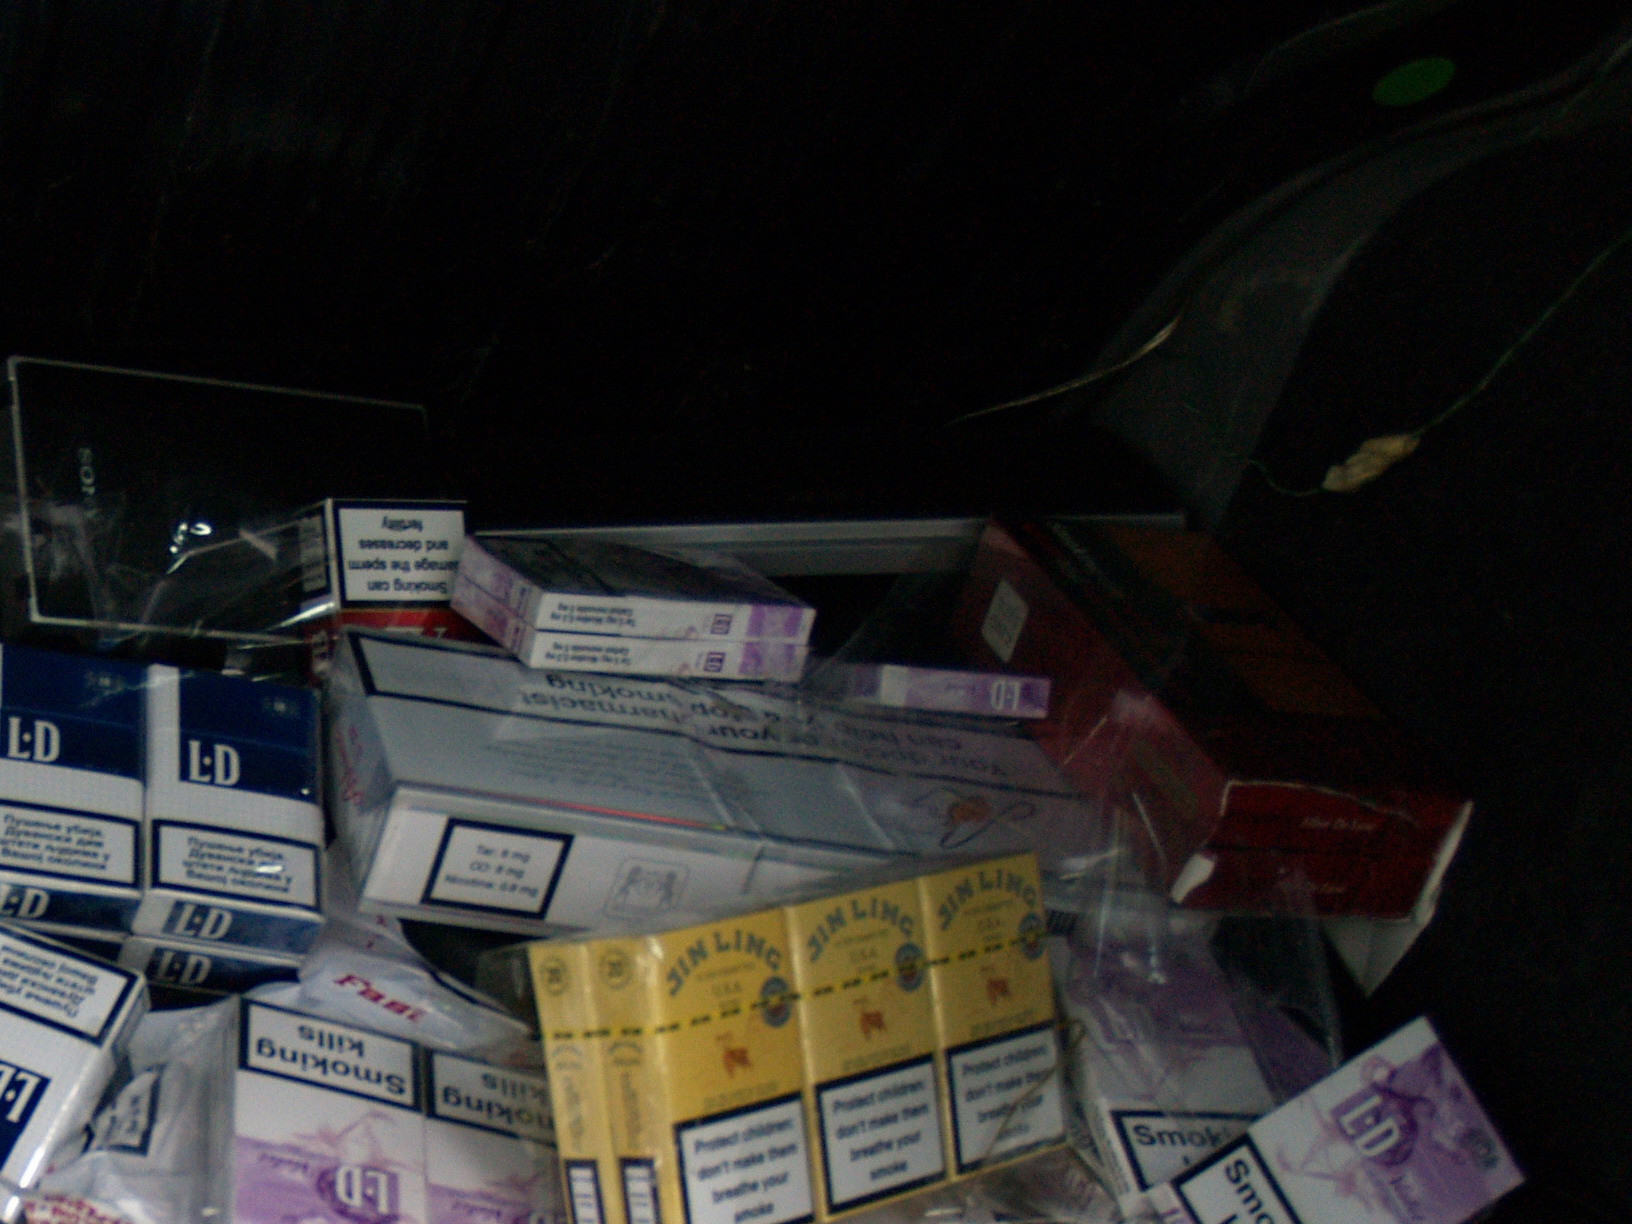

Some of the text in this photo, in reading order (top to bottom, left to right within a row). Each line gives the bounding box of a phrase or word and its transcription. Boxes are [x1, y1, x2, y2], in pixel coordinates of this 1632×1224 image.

[426, 540, 449, 552] and
[367, 581, 390, 591] can
[545, 673, 672, 704] moking
[521, 690, 681, 724] harmacist
[298, 1022, 367, 1057] kills
[255, 1036, 407, 1095] Smoking
[833, 1092, 875, 1114] Protect
[868, 1112, 899, 1130] make
[694, 1132, 739, 1155] Protect
[1132, 1123, 1224, 1148] Smok
[734, 1152, 765, 1169] make
